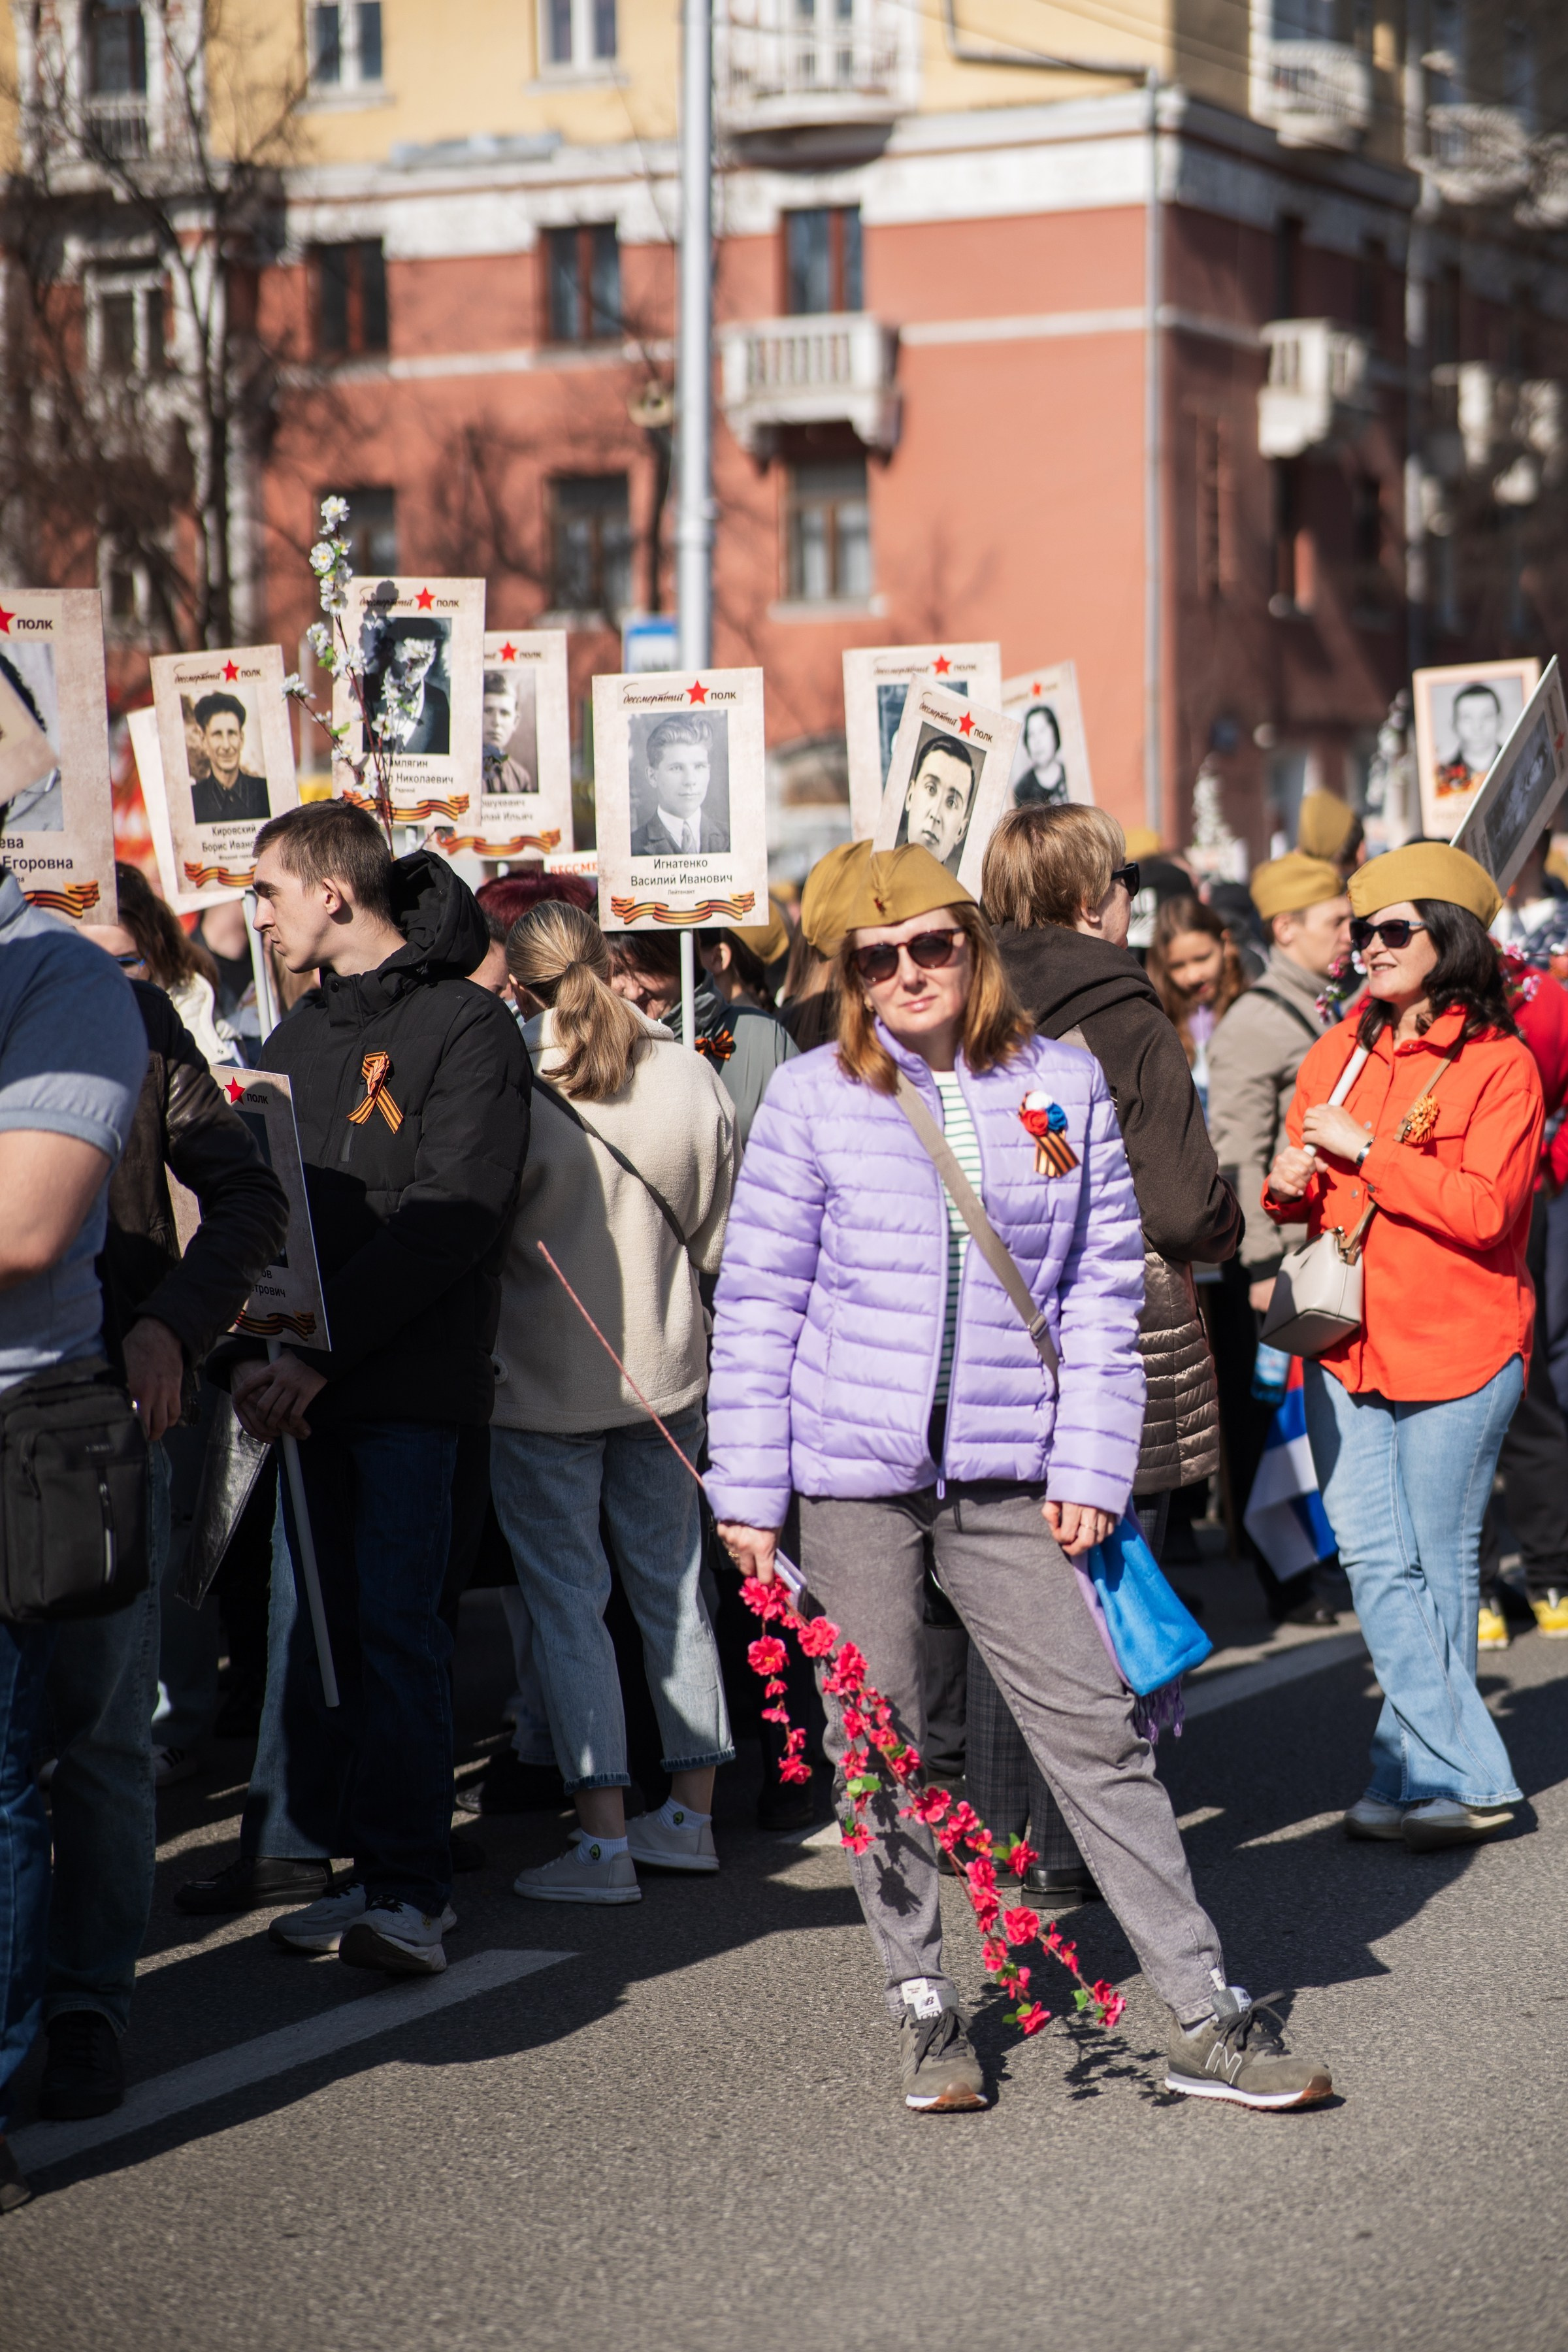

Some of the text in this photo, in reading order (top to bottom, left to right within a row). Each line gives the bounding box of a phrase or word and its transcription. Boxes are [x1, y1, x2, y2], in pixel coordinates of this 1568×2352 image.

[396, 773, 453, 784] Николаевич
[211, 825, 256, 838] Кировский
[3, 855, 73, 873] Егоровна
[654, 858, 708, 870] Игнатенко
[630, 874, 732, 887] Василий Иванович
